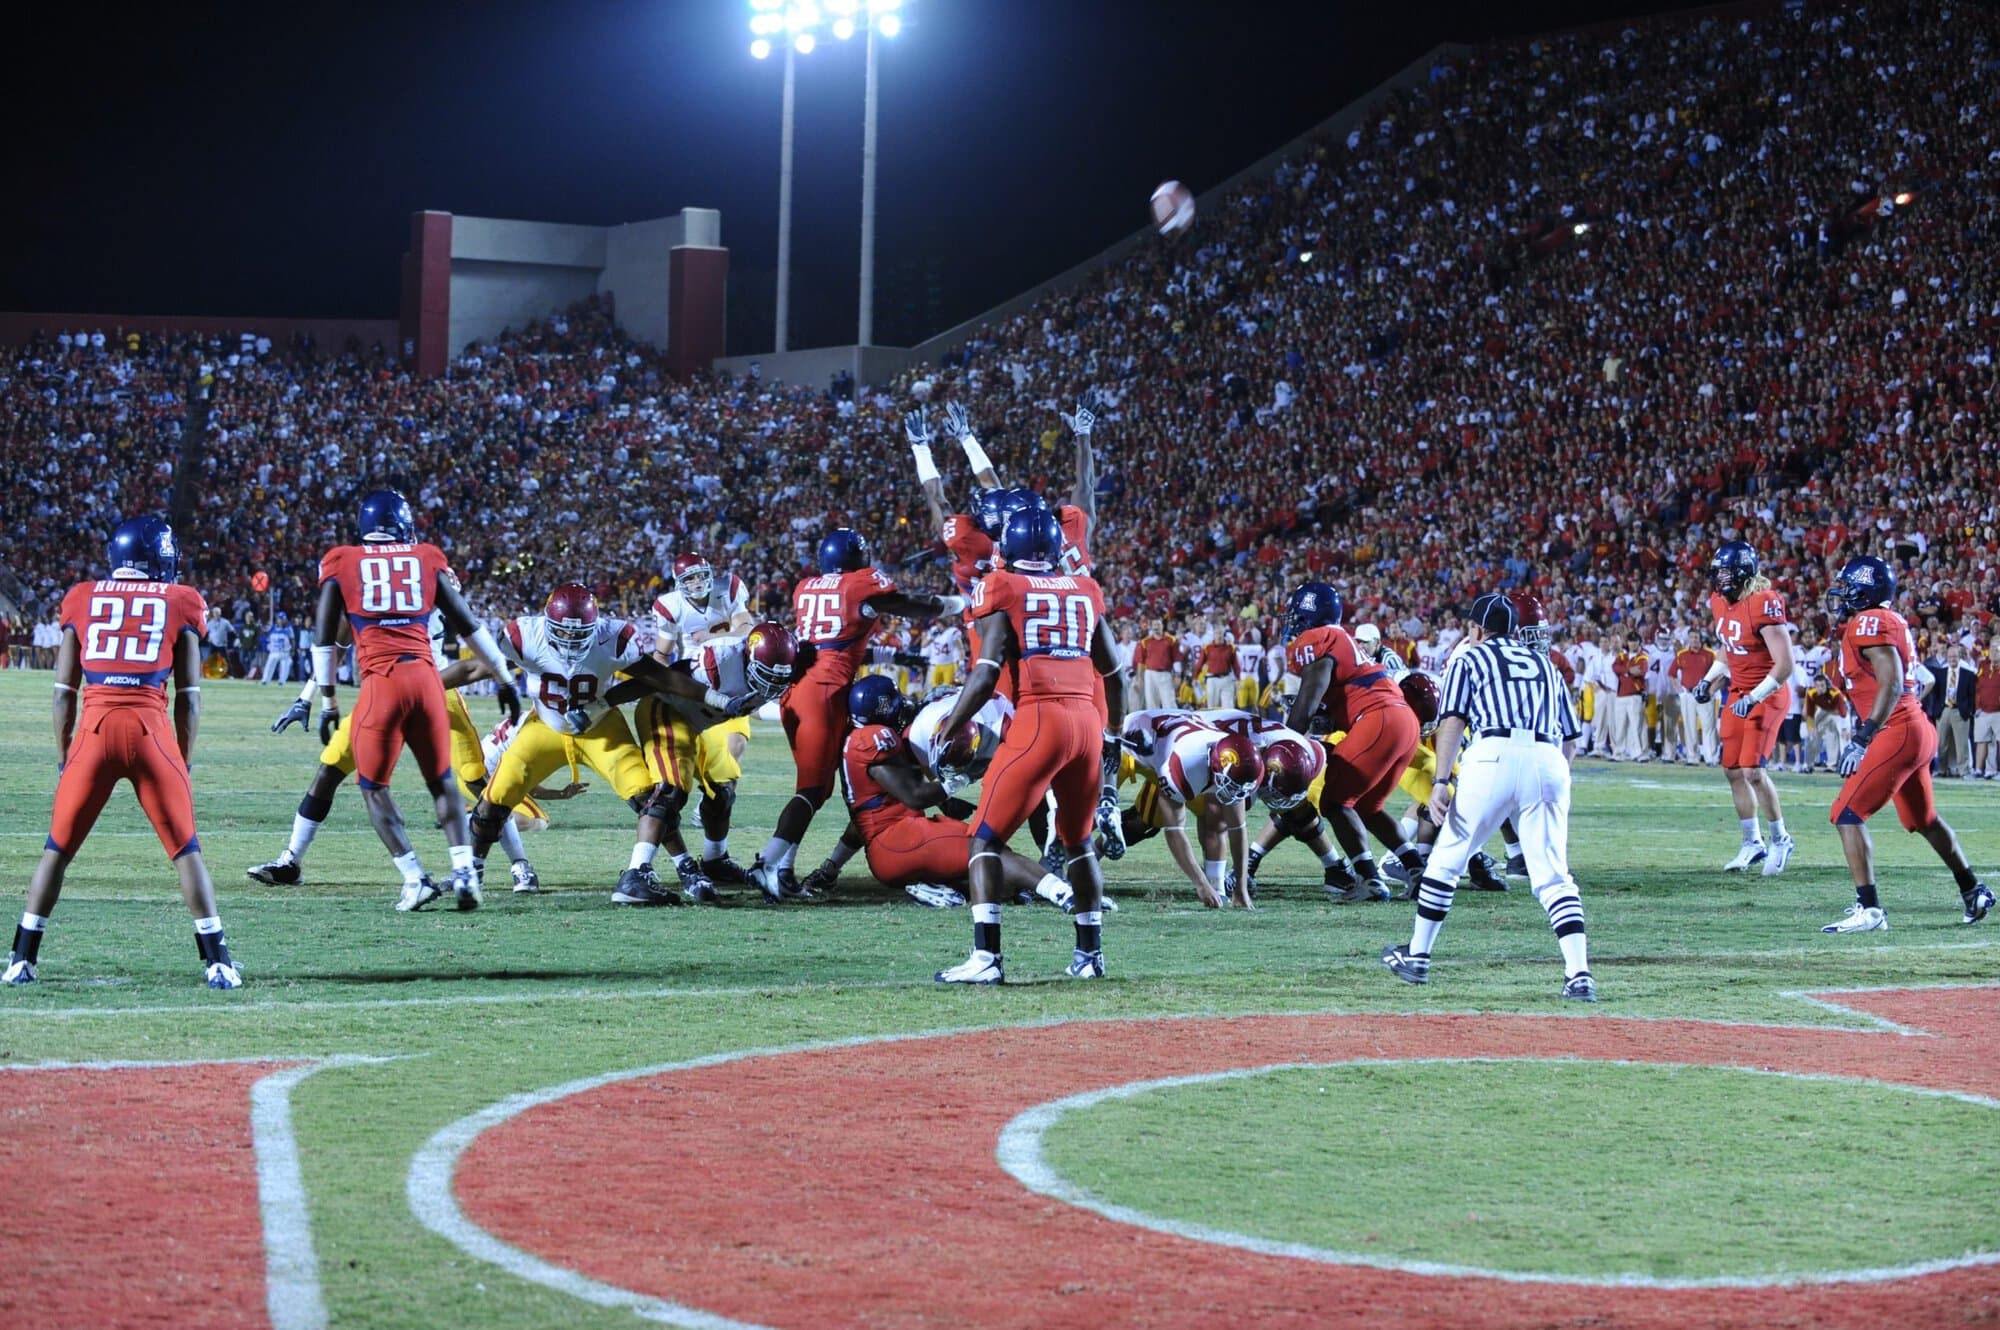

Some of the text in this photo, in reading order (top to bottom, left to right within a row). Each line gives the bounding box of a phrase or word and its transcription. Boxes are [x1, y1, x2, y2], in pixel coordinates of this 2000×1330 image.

[360, 556, 422, 612] 83
[1026, 576, 1081, 590] NELSON
[85, 597, 167, 663] 23
[794, 593, 842, 642] 35
[1025, 593, 1096, 653] 20
[1856, 616, 1880, 637] 33
[1050, 649, 1082, 658] ARIZONA
[1715, 617, 1749, 656] 42
[103, 675, 141, 686] ARIZONA
[1243, 655, 1259, 673] 17
[1501, 646, 1541, 680] S
[539, 672, 600, 716] 68
